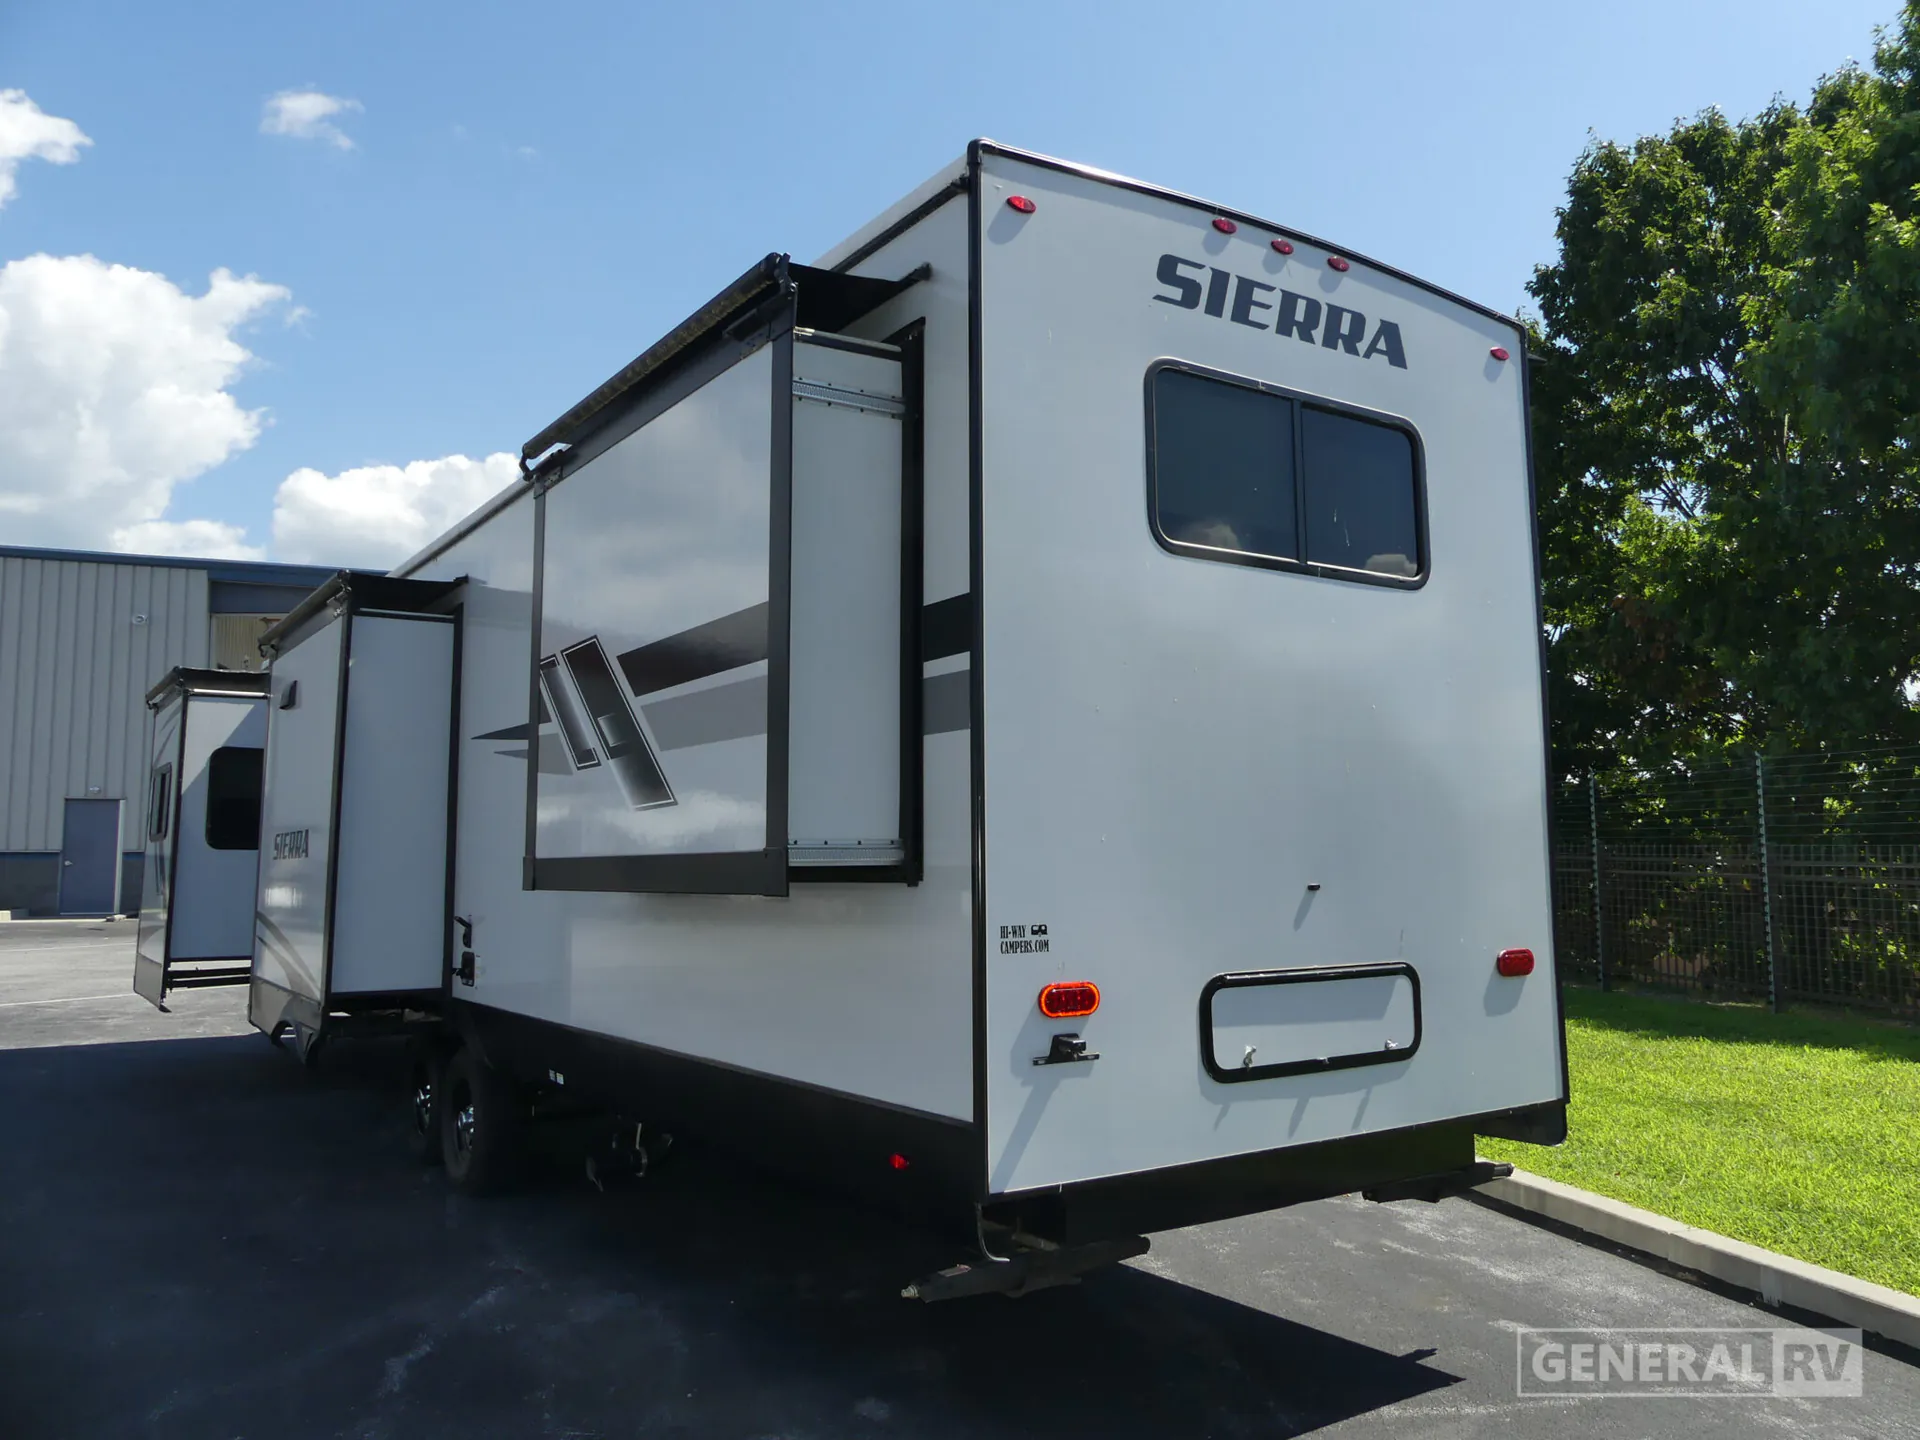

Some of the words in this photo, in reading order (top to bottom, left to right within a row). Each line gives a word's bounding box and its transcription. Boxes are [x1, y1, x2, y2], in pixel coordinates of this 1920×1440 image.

[1152, 253, 1408, 370] SIERRA
[273, 829, 309, 860] SIERRA
[1000, 939, 1050, 955] CAMPERS.COM
